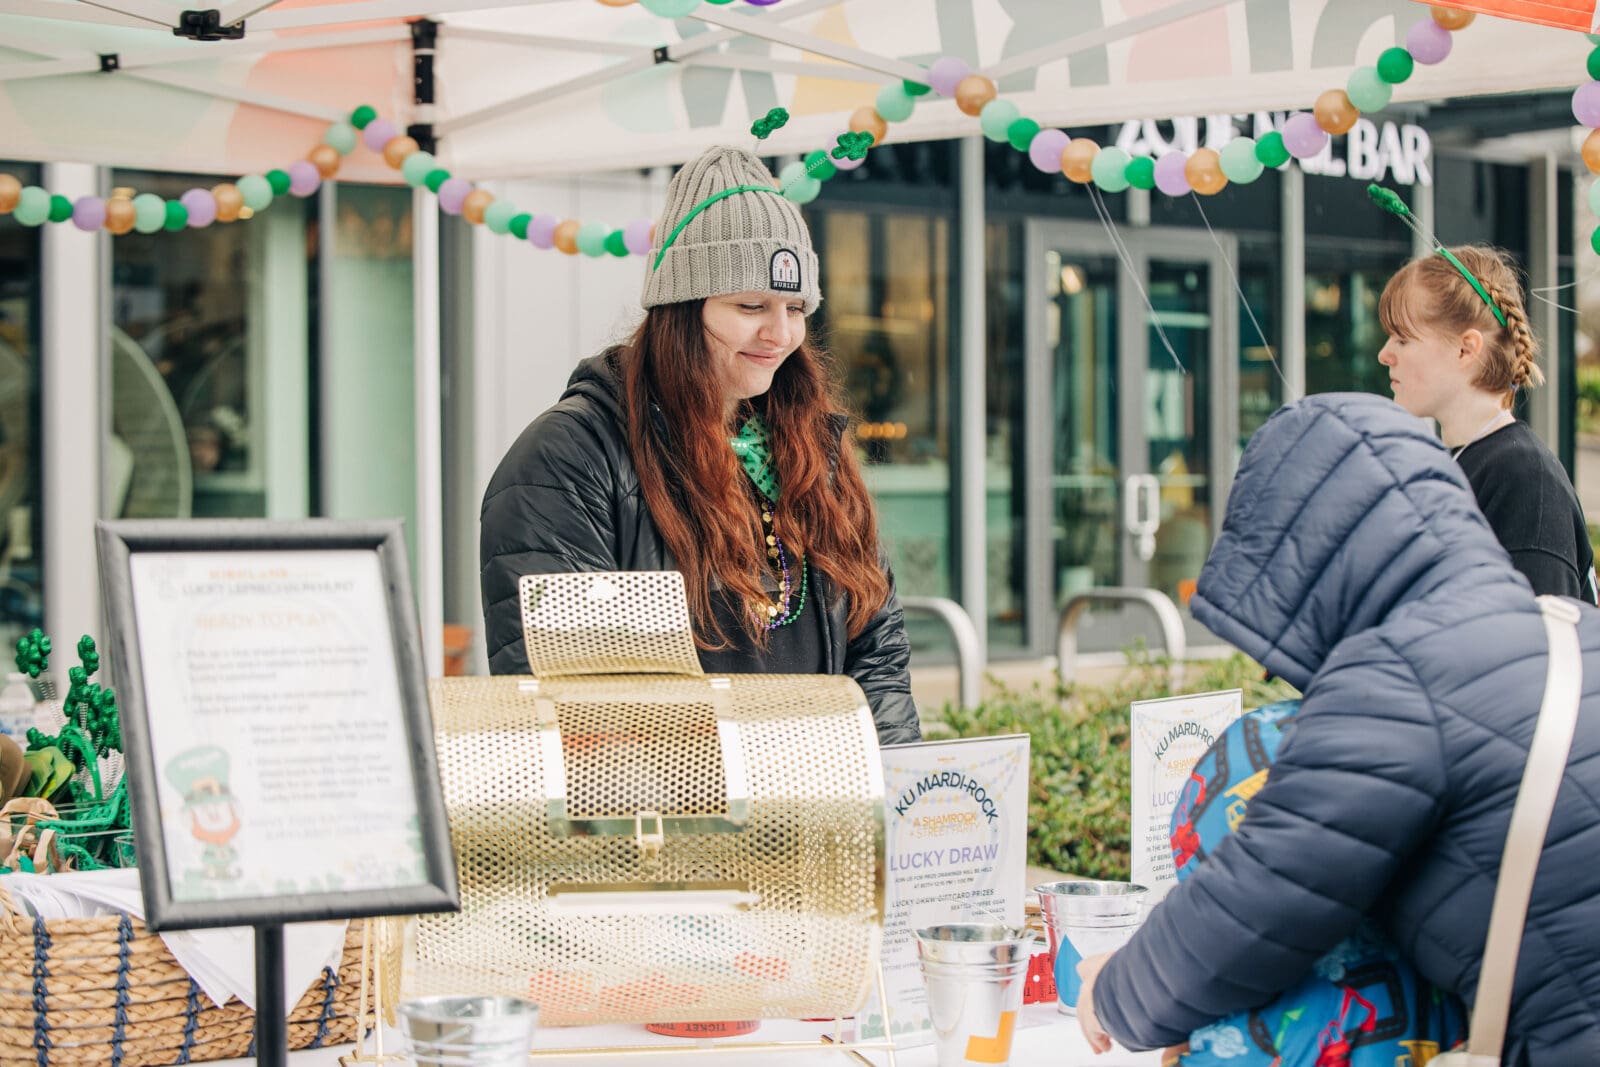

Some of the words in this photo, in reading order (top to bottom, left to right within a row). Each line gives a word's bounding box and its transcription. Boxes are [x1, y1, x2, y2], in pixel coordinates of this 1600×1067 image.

[1347, 117, 1432, 187] BAR
[1155, 736, 1168, 760] KU
[1169, 722, 1215, 748] MARDI-RO
[895, 789, 916, 816] KU
[916, 772, 999, 824] MARDI-ROCK
[1152, 790, 1180, 807] LUCK
[913, 817, 920, 826] A
[922, 811, 977, 825] SHAMROCK
[890, 850, 945, 872] LUCKY
[949, 843, 999, 865] DRAW
[892, 899, 914, 908] LUCKY
[972, 888, 994, 896] PRIZES
[685, 1022, 726, 1032] TICKET
